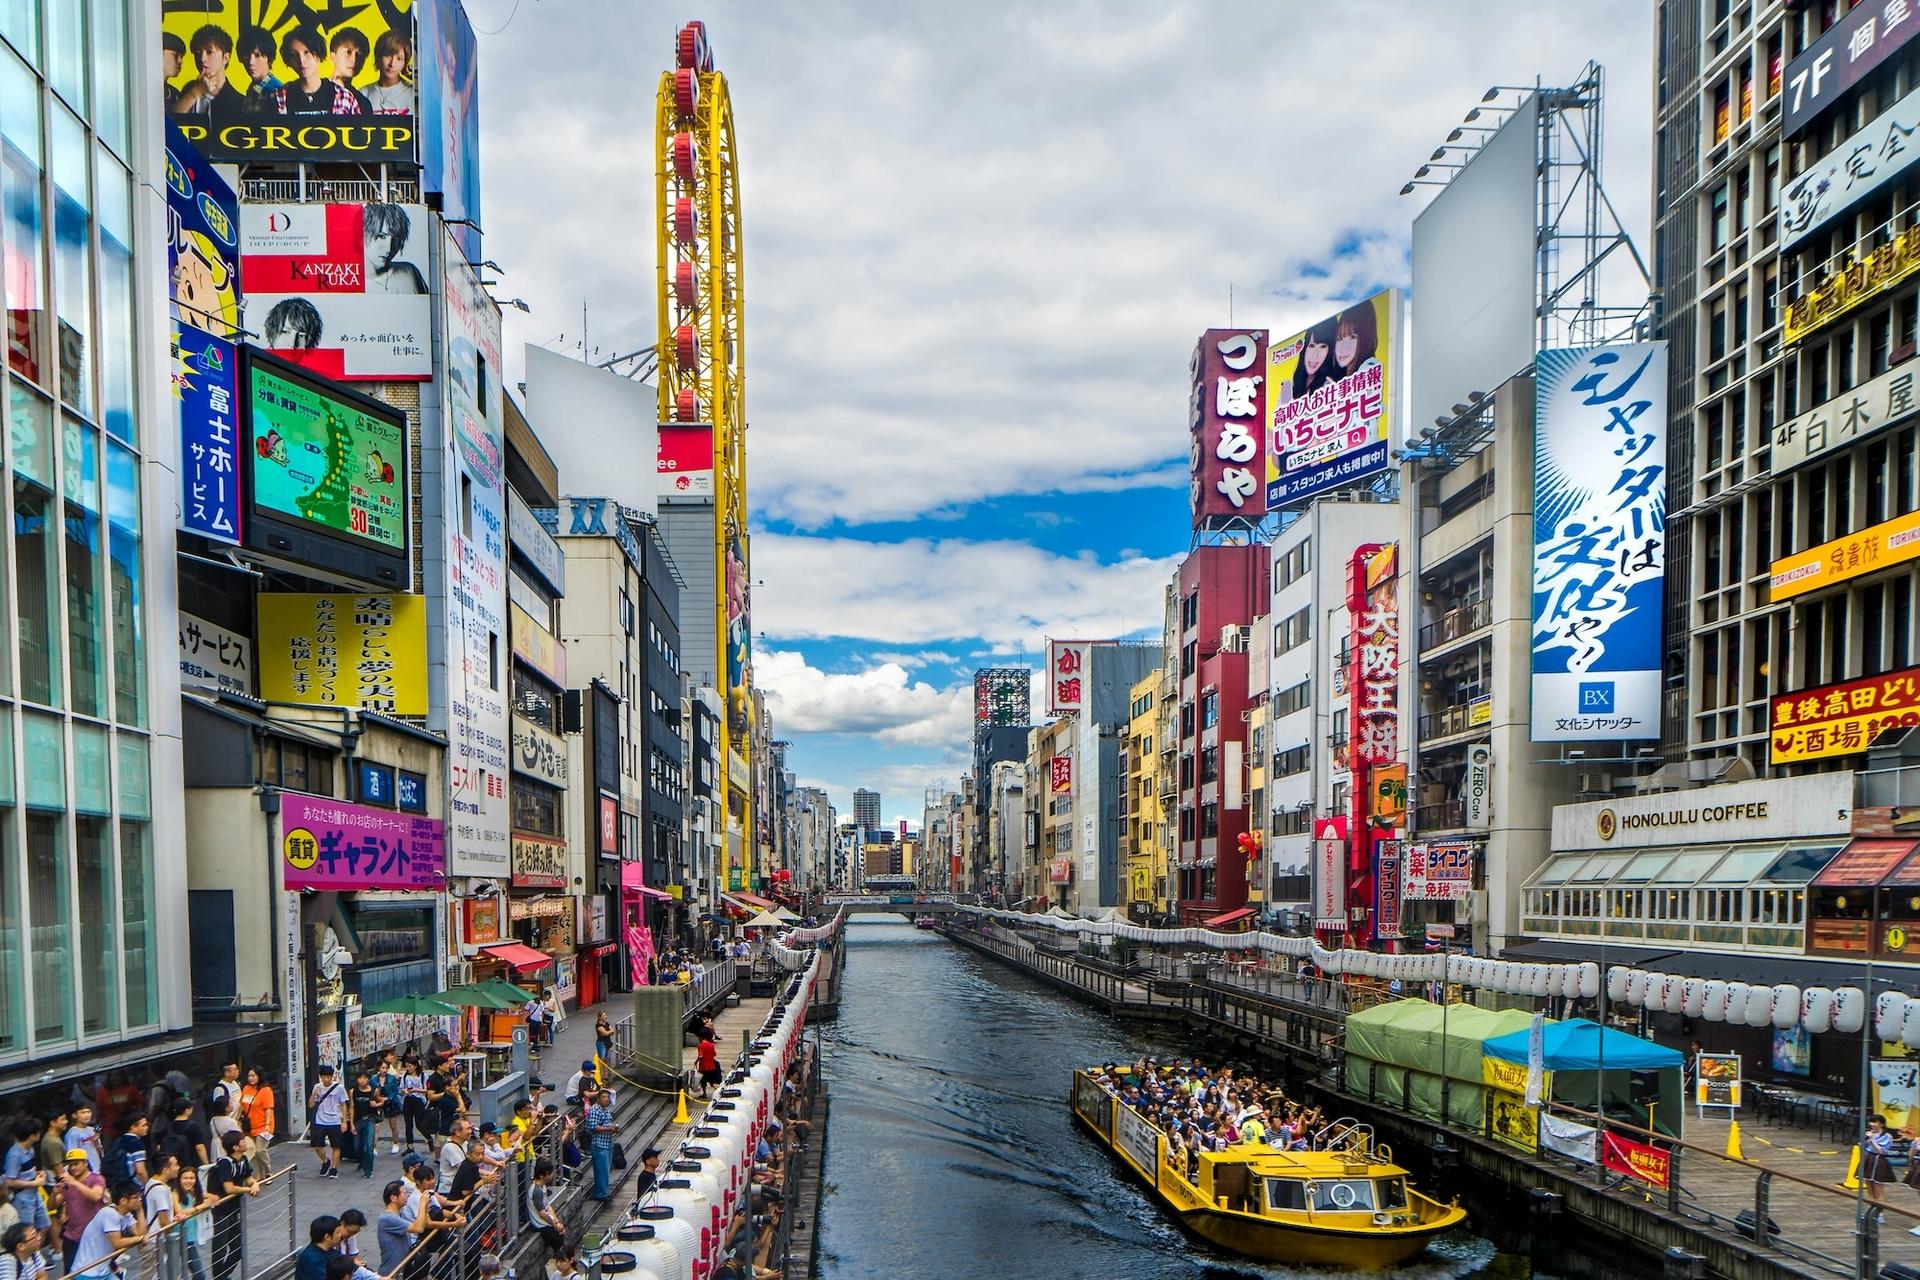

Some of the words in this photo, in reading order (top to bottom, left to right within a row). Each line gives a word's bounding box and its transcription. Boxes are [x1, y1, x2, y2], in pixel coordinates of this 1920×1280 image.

[1790, 47, 1833, 114] 7F
[220, 125, 411, 150] GROUP
[1845, 121, 1915, 191] 完全
[290, 260, 360, 281] KANZAKI
[317, 273, 360, 290] RUKA
[340, 334, 414, 343] めっちゃ面白いを
[1274, 364, 1382, 427] 高収入お仕事情報
[1274, 385, 1382, 453] いちごナビ
[1776, 421, 1798, 448] 4F
[1805, 372, 1917, 456] 白木屋
[208, 383, 234, 534] 富士ホーム
[1289, 446, 1325, 468] いちごナビ
[1327, 440, 1343, 454] 求人
[190, 442, 208, 521] サービス
[350, 507, 368, 534] 30
[315, 599, 337, 703] あなたのお店づくり
[354, 596, 396, 713] 素晴らしい夢の実現
[289, 637, 313, 696] 応援します
[1359, 604, 1400, 762] 大阪王将
[1584, 689, 1610, 707] BX
[1796, 721, 1864, 755] 酒場
[369, 770, 380, 797] 酒
[398, 777, 417, 804] たばこ
[453, 766, 478, 791] コスパ
[1472, 766, 1483, 797] ZERO
[1621, 809, 1699, 830] HONOLULU
[1702, 802, 1768, 821] COFFEE
[288, 837, 315, 860] 賃貸
[319, 829, 411, 877] ギャラント
[1409, 848, 1425, 878] 薬
[1429, 848, 1469, 869] ダイコク
[316, 863, 324, 876] の
[1425, 881, 1451, 898] 免税
